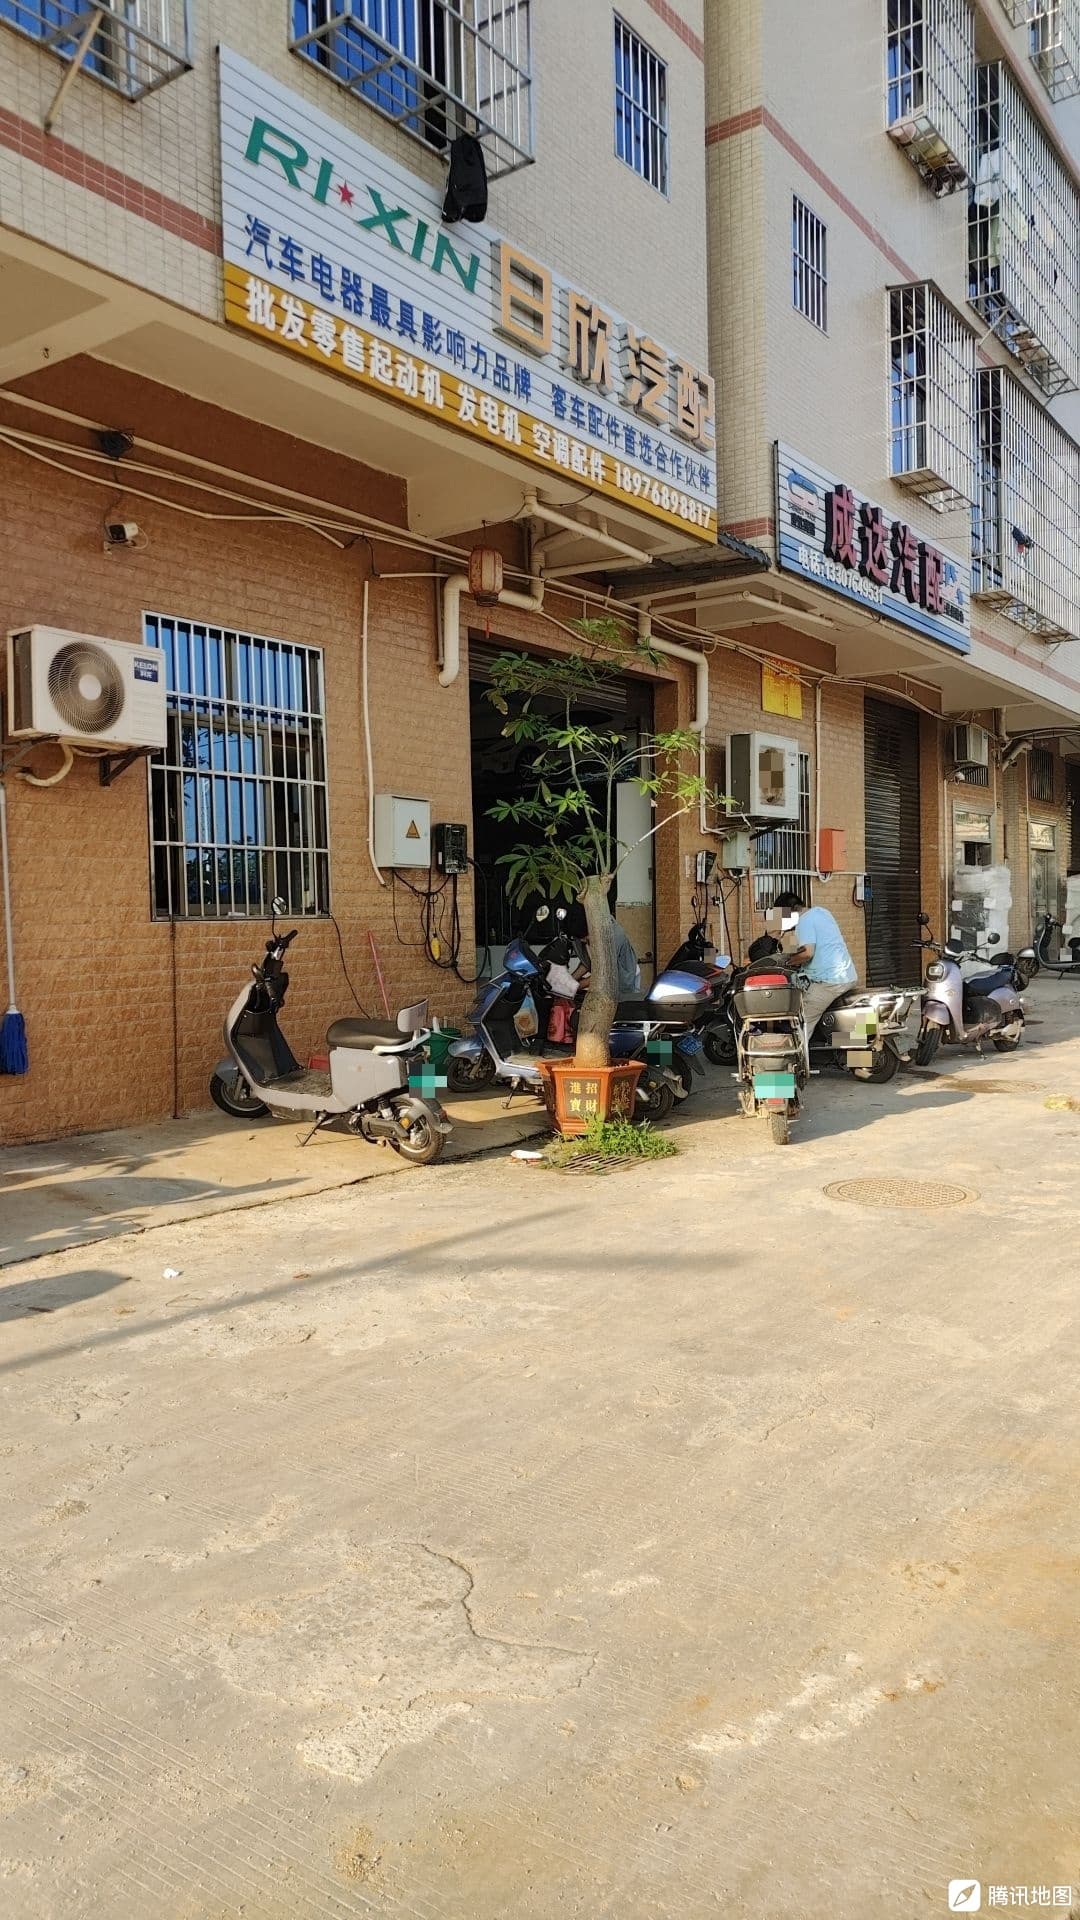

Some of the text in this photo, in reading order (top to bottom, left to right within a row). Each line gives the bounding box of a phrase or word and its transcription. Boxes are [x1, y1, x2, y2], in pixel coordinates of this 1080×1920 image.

[244, 213, 532, 404] 汽车电器最具影响力品牌
[245, 277, 711, 528] 批发零售起动机 发电机 空调配件 18976898817
[494, 241, 715, 449] 日欣汽配
[551, 384, 711, 494] 客车配件首选合作伙伴
[824, 484, 944, 615] 成达汽配
